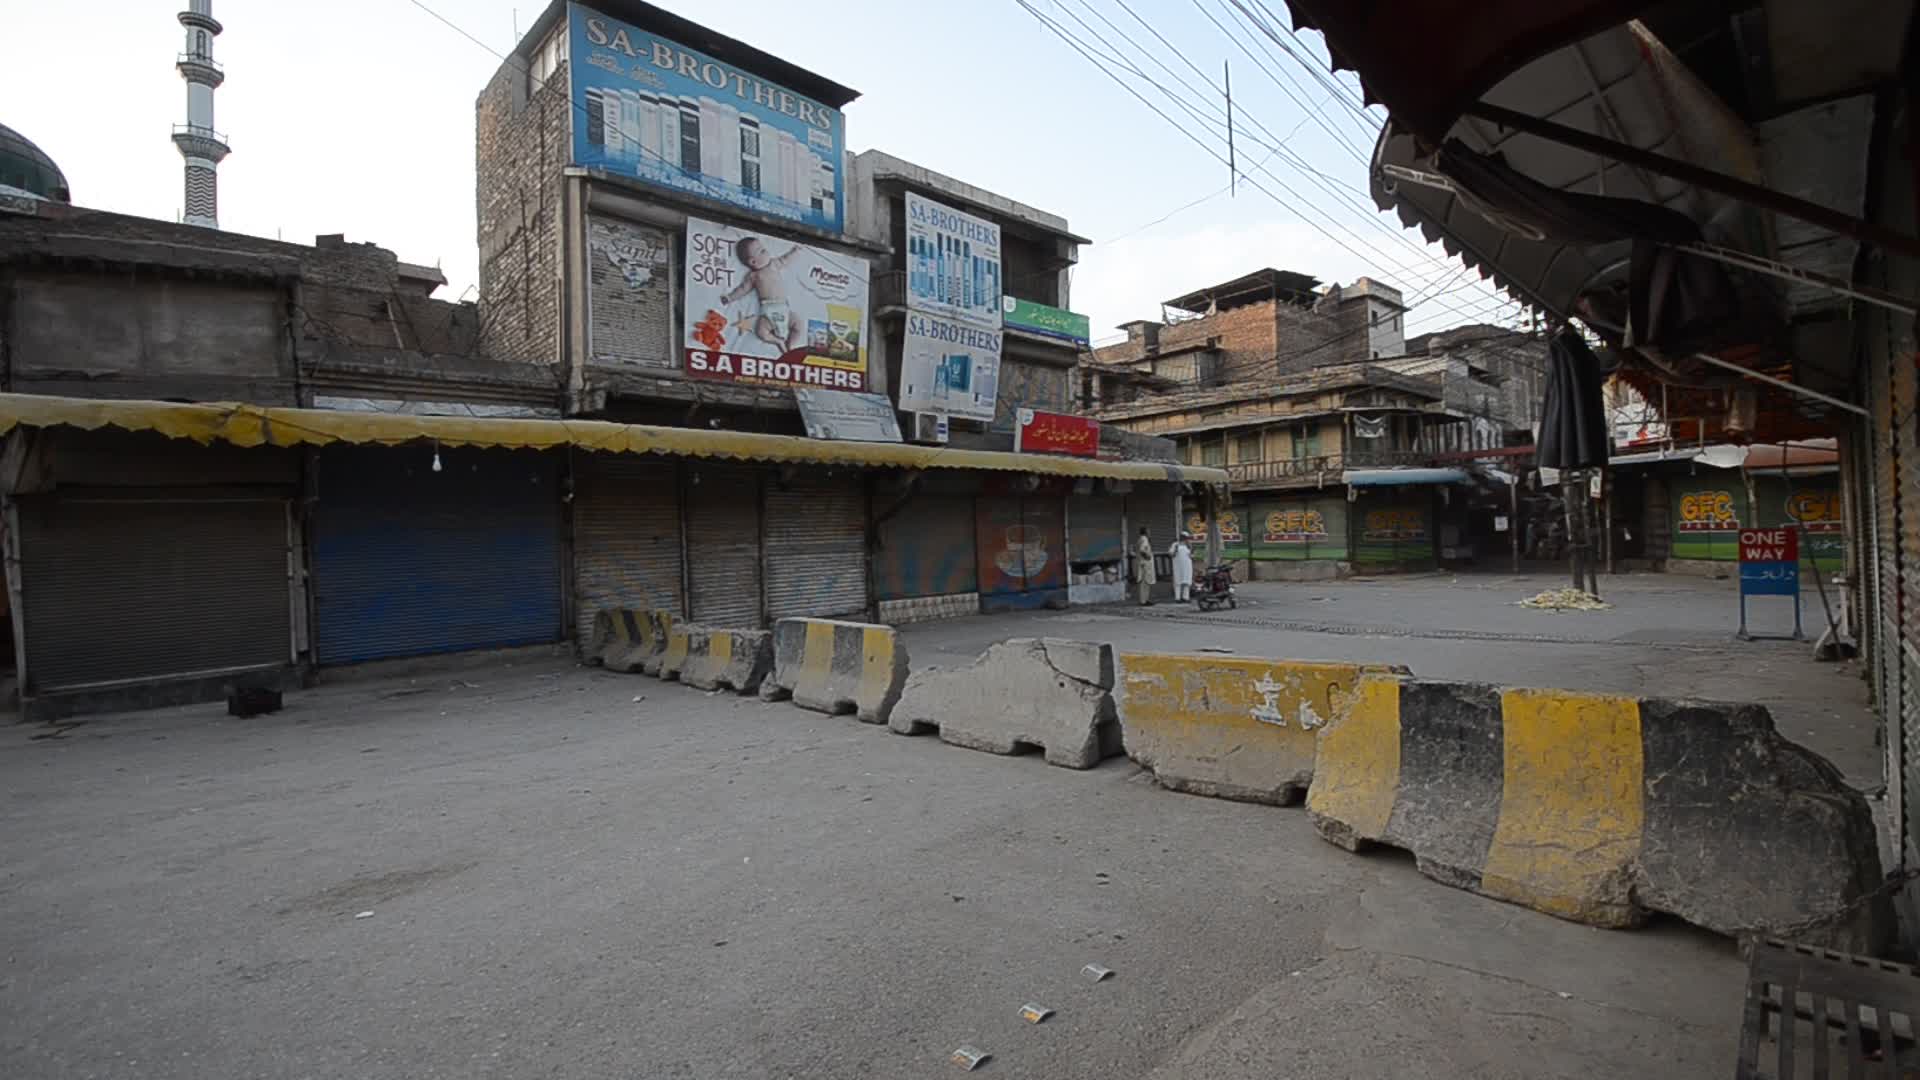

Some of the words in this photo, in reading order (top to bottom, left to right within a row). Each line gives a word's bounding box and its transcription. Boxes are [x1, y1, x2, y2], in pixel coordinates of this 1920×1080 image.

[586, 18, 832, 130] SA-BROTHERS
[910, 200, 998, 247] SA-BROTHERS
[692, 232, 736, 258] SOFT
[692, 264, 735, 287] SOFT
[908, 315, 1001, 353] SA-BROTHERS
[690, 350, 733, 374] S.A
[740, 357, 862, 388] BROTHERS
[1680, 490, 1735, 521] GFC
[1265, 509, 1325, 534] GFC
[1741, 530, 1787, 545] ONE
[1745, 546, 1785, 561] WAY
